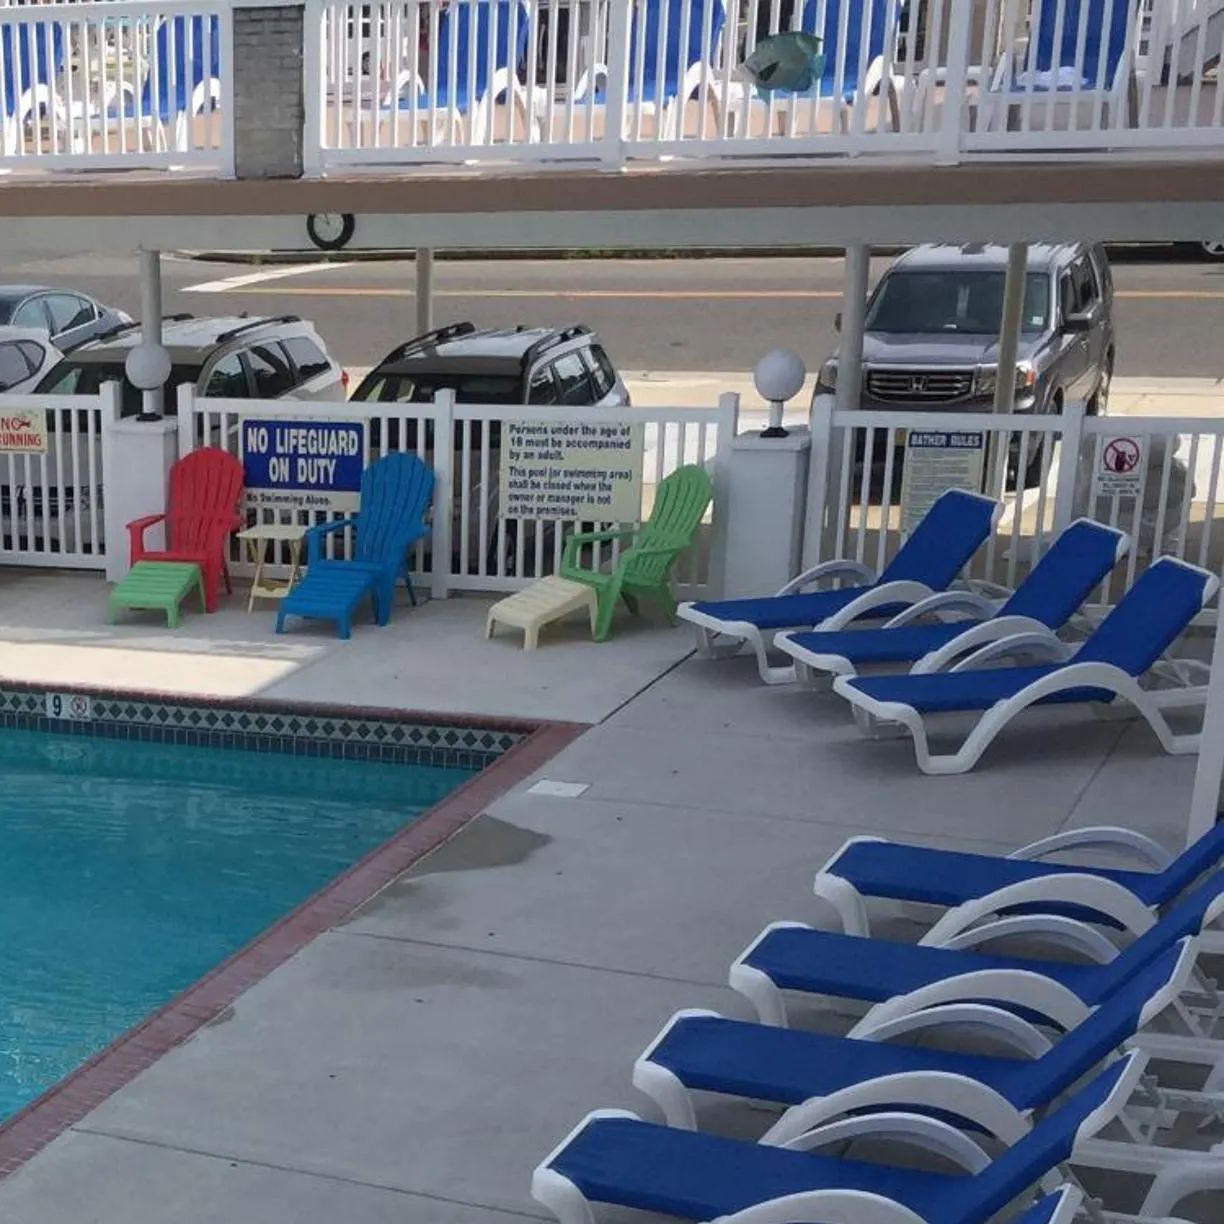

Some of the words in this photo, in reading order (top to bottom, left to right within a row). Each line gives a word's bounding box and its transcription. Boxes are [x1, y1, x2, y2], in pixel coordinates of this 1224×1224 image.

[1, 417, 22, 431] NO
[509, 424, 548, 435] Persons
[551, 425, 579, 435] under
[581, 425, 597, 436] the
[600, 427, 617, 437] age
[621, 426, 630, 436] of
[247, 427, 269, 454] NO
[276, 427, 358, 456] LIFEGUARD
[525, 438, 549, 448] must
[551, 438, 562, 448] be
[566, 439, 631, 450] accompanied
[911, 434, 946, 446] BATHER
[950, 435, 980, 446] RULES
[509, 450, 521, 461] by
[523, 451, 535, 460] an
[538, 451, 564, 460] adult.
[268, 456, 290, 482] ON
[297, 458, 336, 485] DUTY
[509, 466, 526, 477] This
[528, 467, 547, 479] pool
[563, 468, 607, 481] swimming
[508, 480, 529, 489] shall
[530, 480, 541, 489] be
[543, 480, 571, 490] closed
[573, 481, 596, 491] when
[598, 481, 612, 491] the
[260, 492, 304, 505] Swimming
[508, 493, 534, 502] owner
[536, 493, 545, 502] or
[547, 494, 585, 505] manager
[587, 494, 595, 504] is
[597, 494, 611, 504] not
[508, 505, 518, 514] on
[520, 505, 534, 515] the
[53, 695, 62, 717] 9
